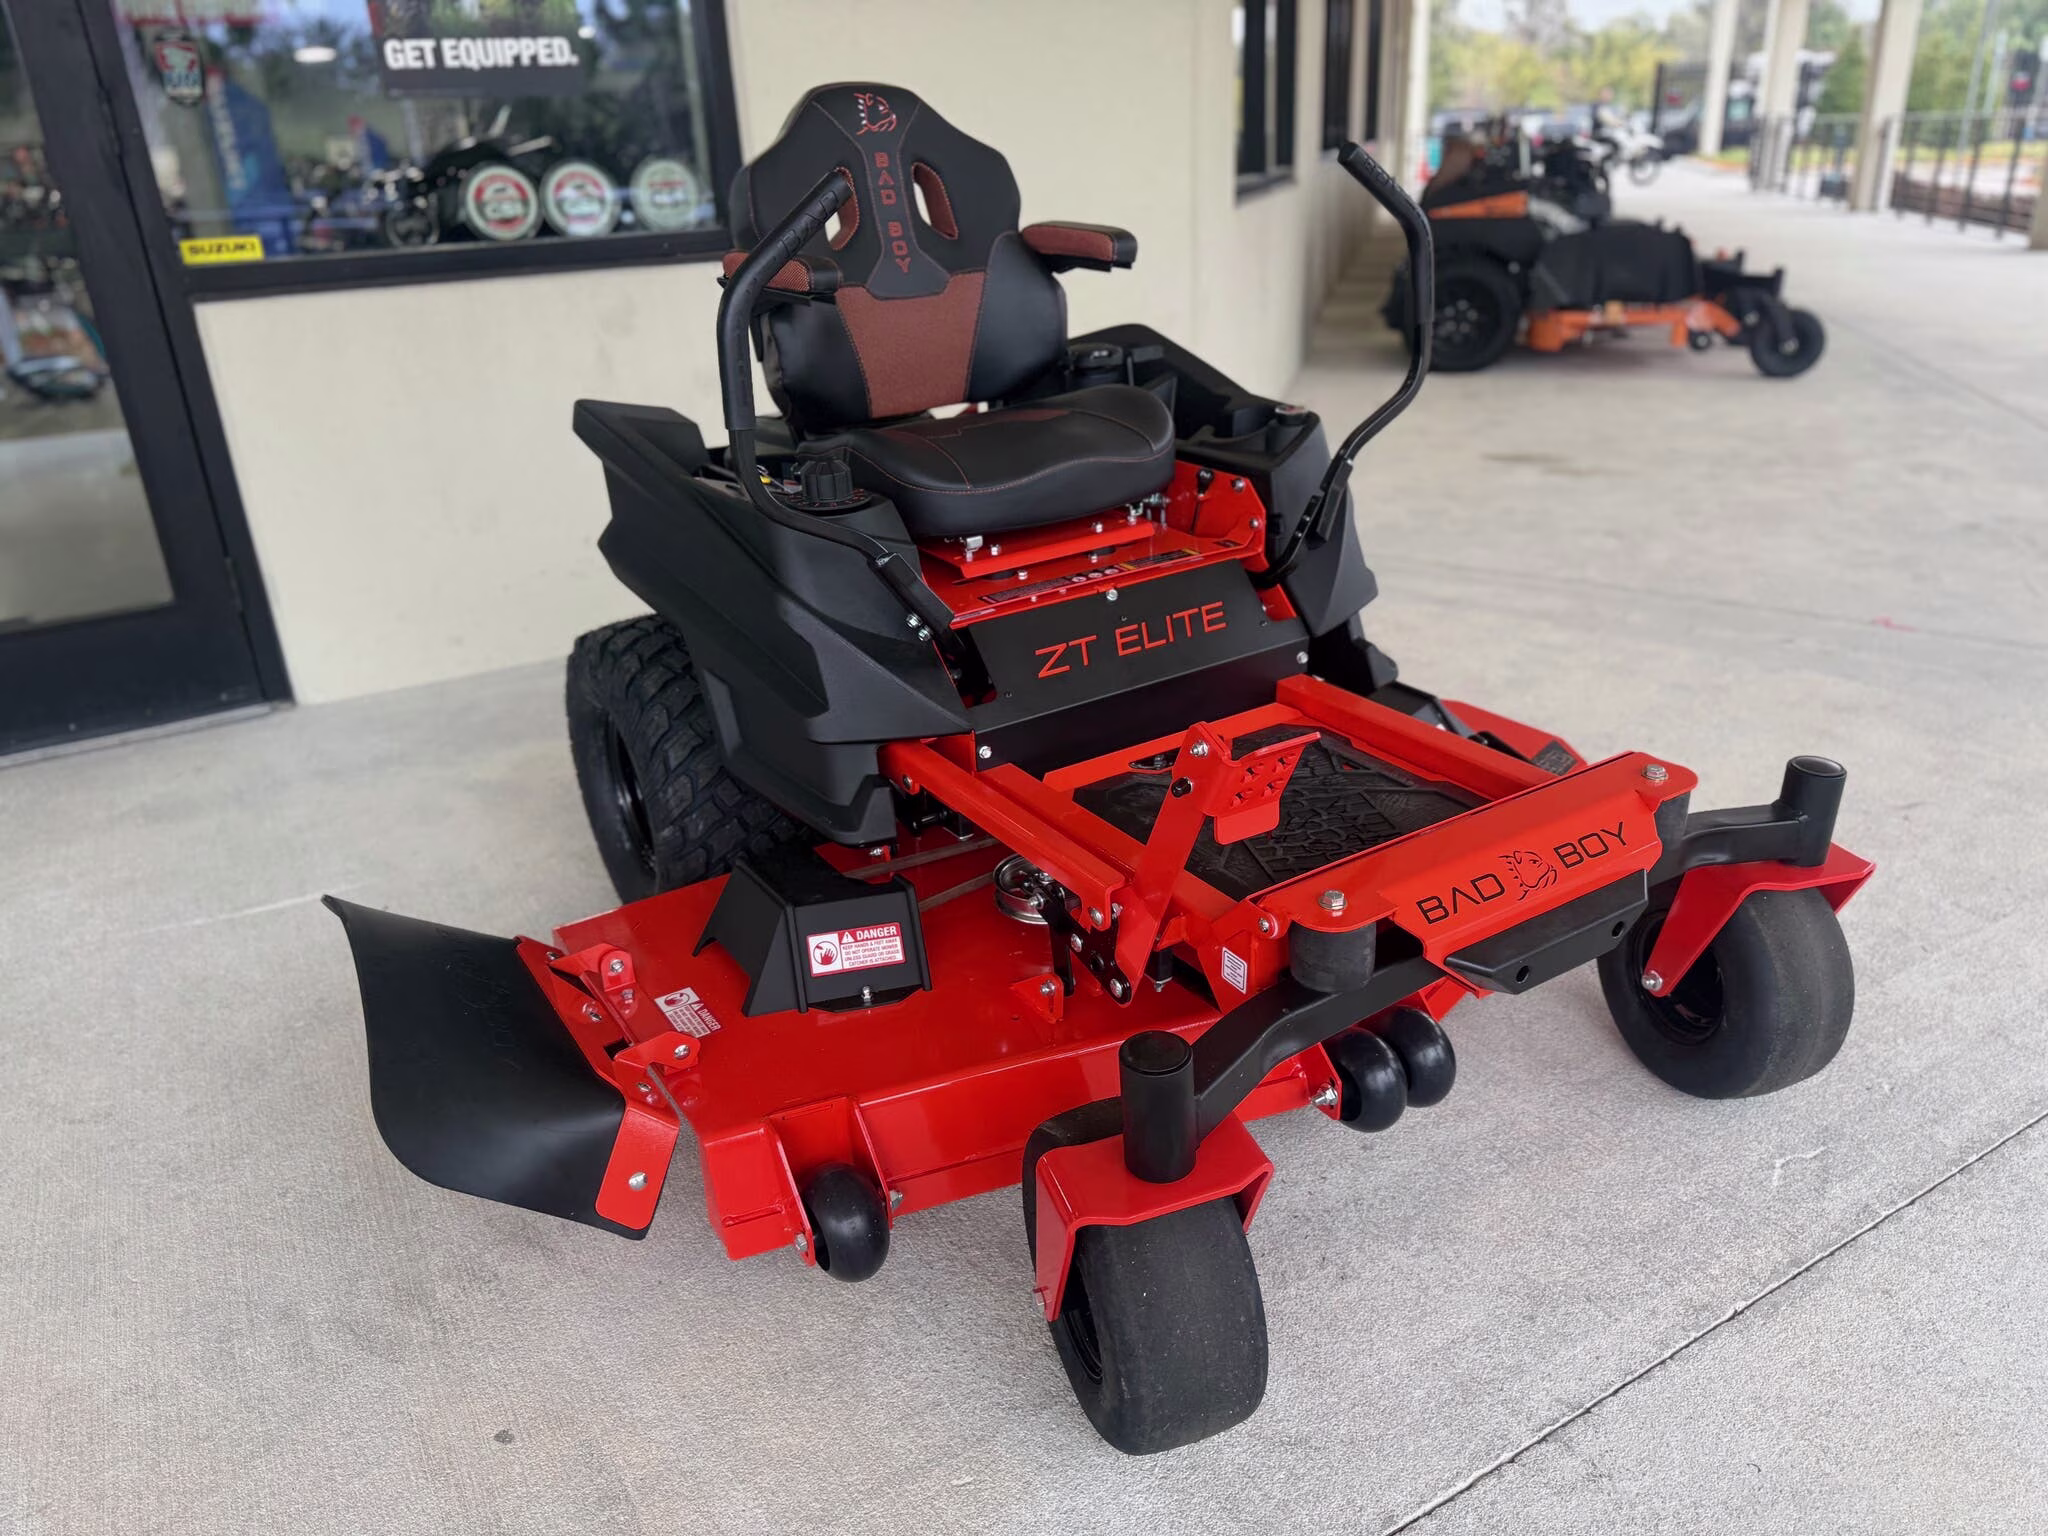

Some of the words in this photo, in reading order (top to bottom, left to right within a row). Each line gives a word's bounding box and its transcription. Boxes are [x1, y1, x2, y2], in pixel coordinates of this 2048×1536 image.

[384, 38, 436, 70] GET
[440, 35, 580, 71] EQUIPPED.
[874, 152, 896, 205] BAD
[888, 222, 911, 272] BOY
[187, 242, 257, 257] SUZUKI
[1035, 635, 1097, 678] ZT
[1115, 601, 1227, 656] ELITE
[1416, 873, 1505, 924] BAD
[1553, 821, 1627, 869] BOY
[856, 926, 897, 941] DANGER
[697, 1008, 722, 1032] DANGER
